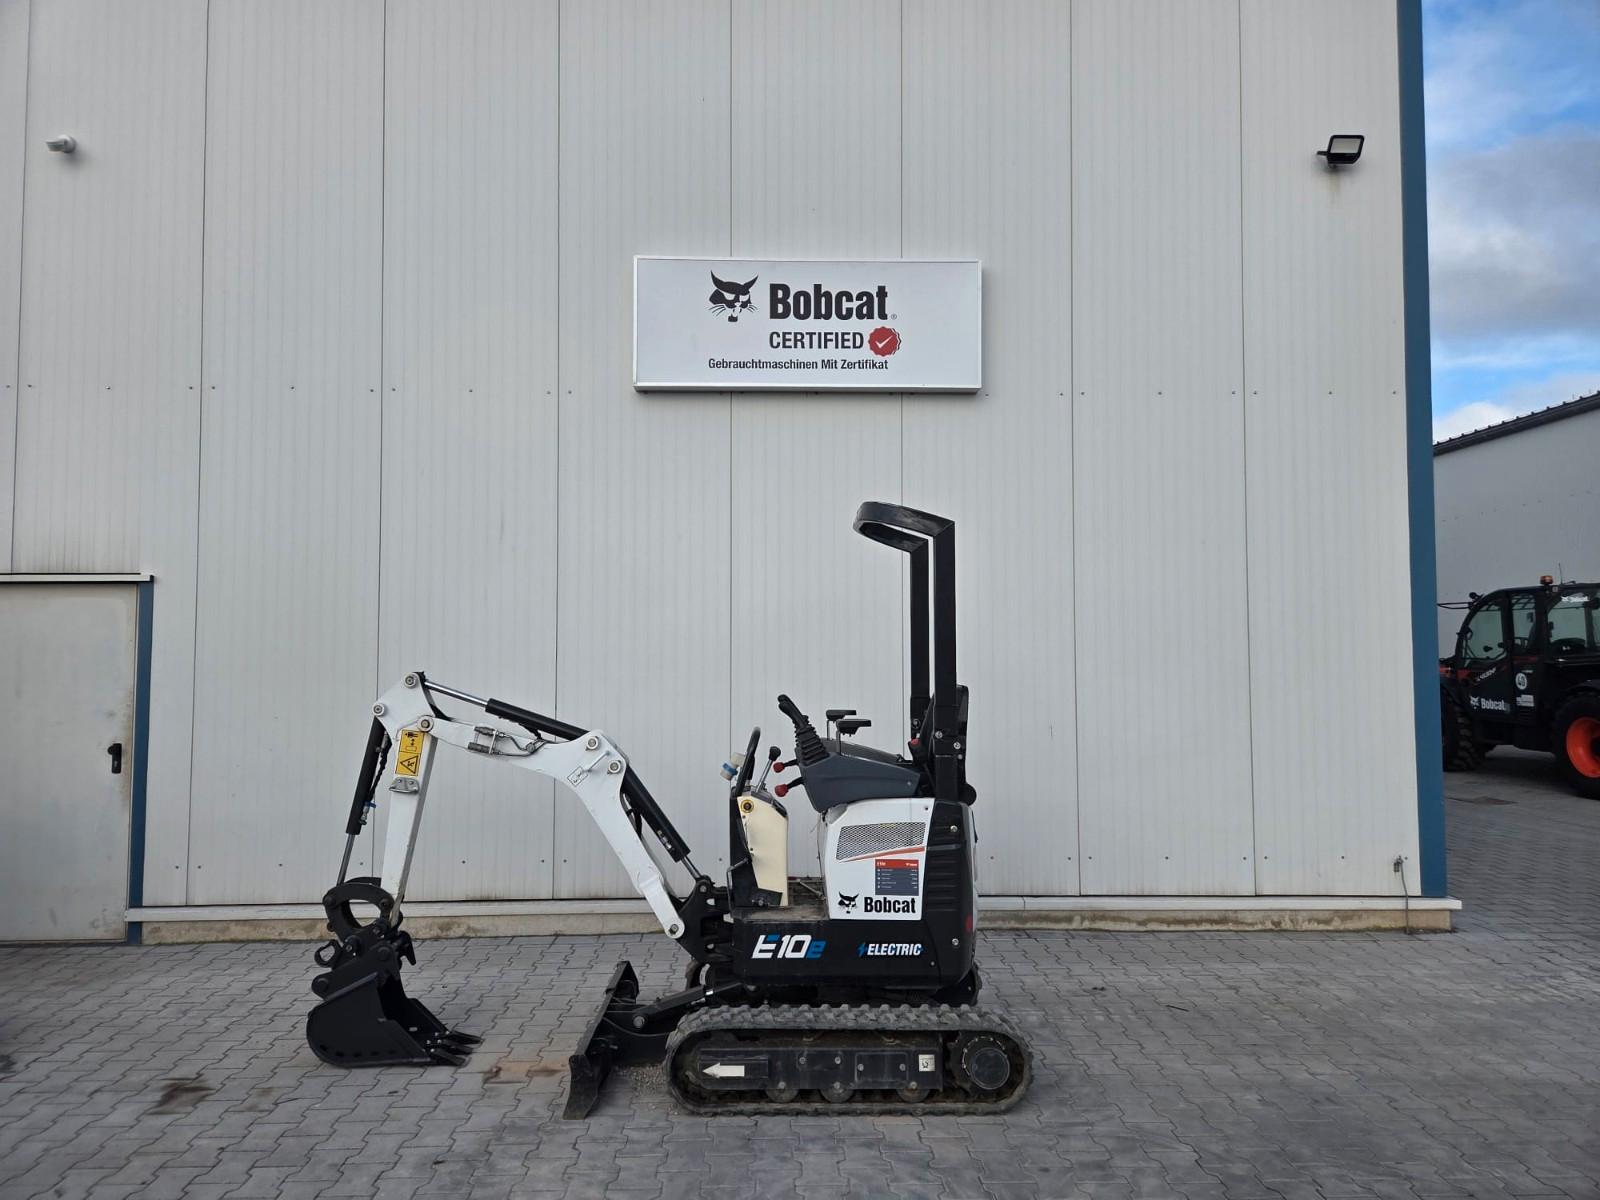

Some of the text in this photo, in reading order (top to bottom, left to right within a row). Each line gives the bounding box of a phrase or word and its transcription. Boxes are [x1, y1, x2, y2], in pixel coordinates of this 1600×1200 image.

[769, 283, 888, 320] Bobcat
[769, 331, 864, 350] CERTIFIED
[708, 358, 889, 370] Gebrauchtmaschinen Mit Zertifikat
[1480, 698, 1506, 711] Bobcat
[864, 896, 916, 914] Bobcat
[750, 934, 827, 959] E10e
[867, 943, 922, 956] ELECTRIC
